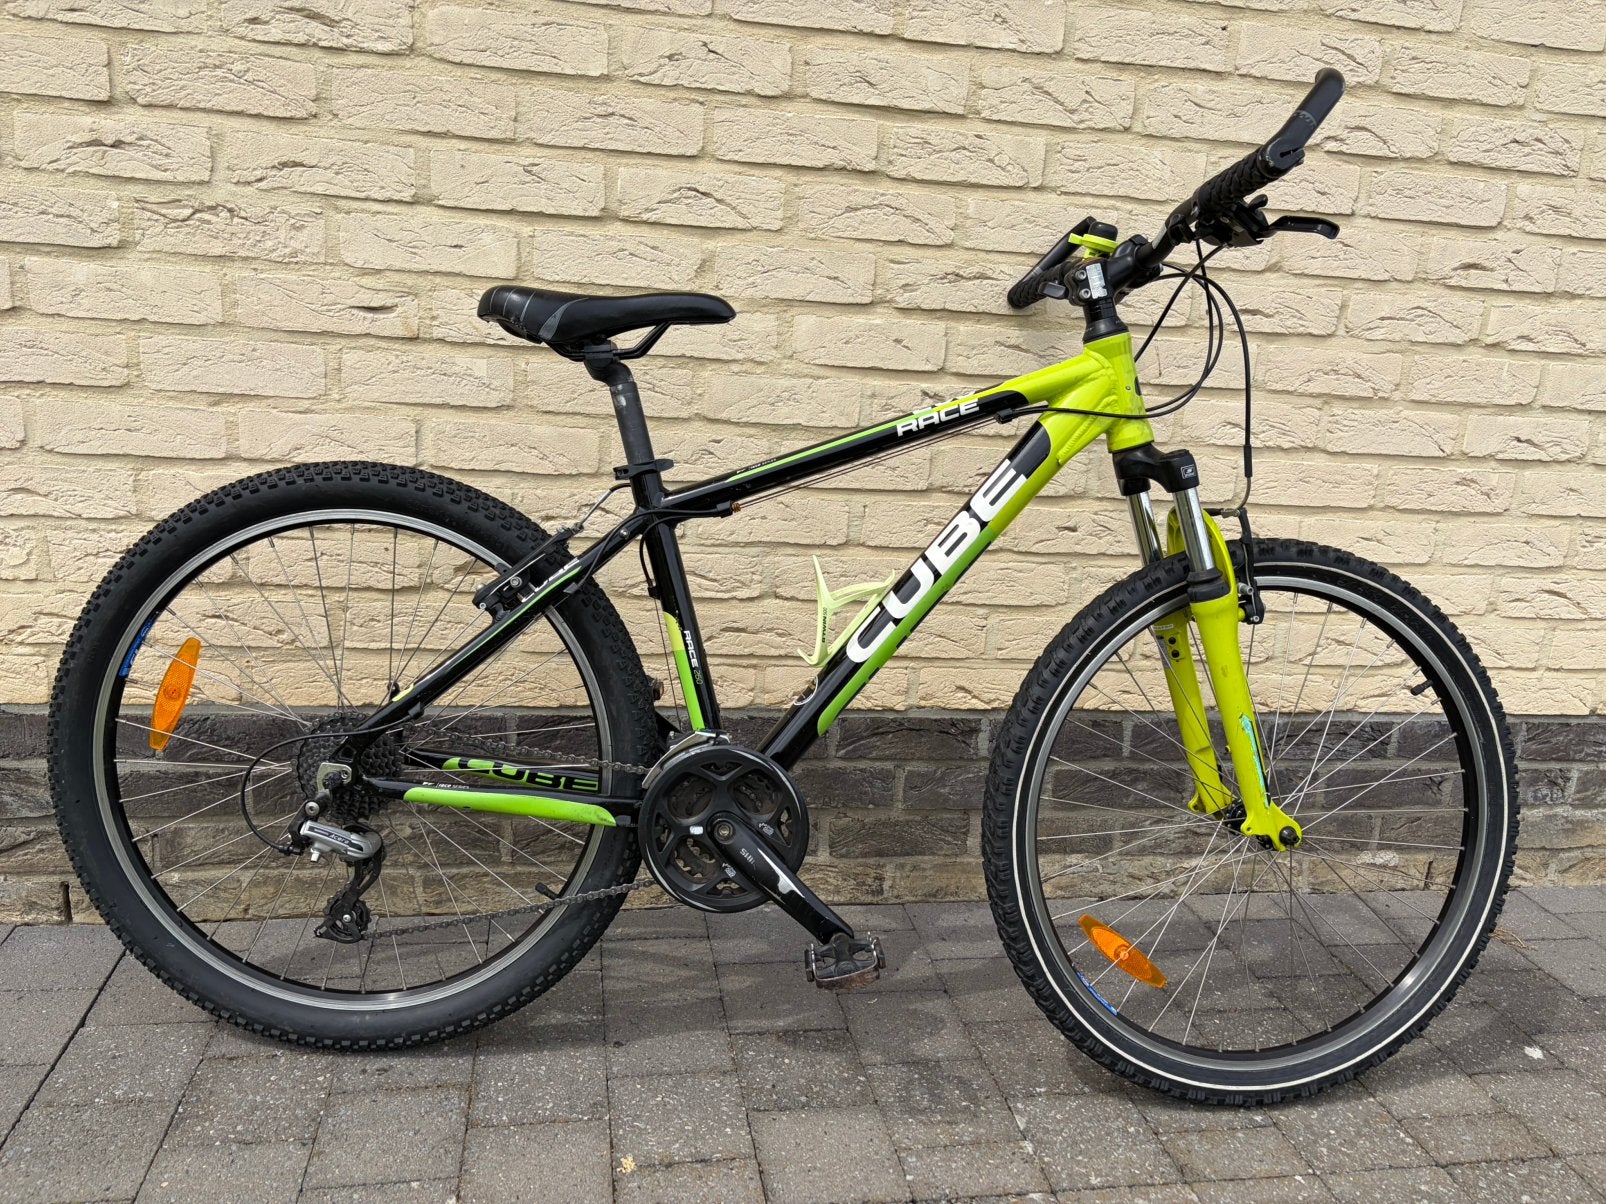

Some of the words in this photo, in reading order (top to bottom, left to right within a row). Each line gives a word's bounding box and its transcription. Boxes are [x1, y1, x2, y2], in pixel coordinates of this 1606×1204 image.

[896, 397, 980, 437] RACE
[846, 458, 1027, 663] CUBE
[683, 630, 699, 668] RACE
[458, 757, 599, 793] CUBE
